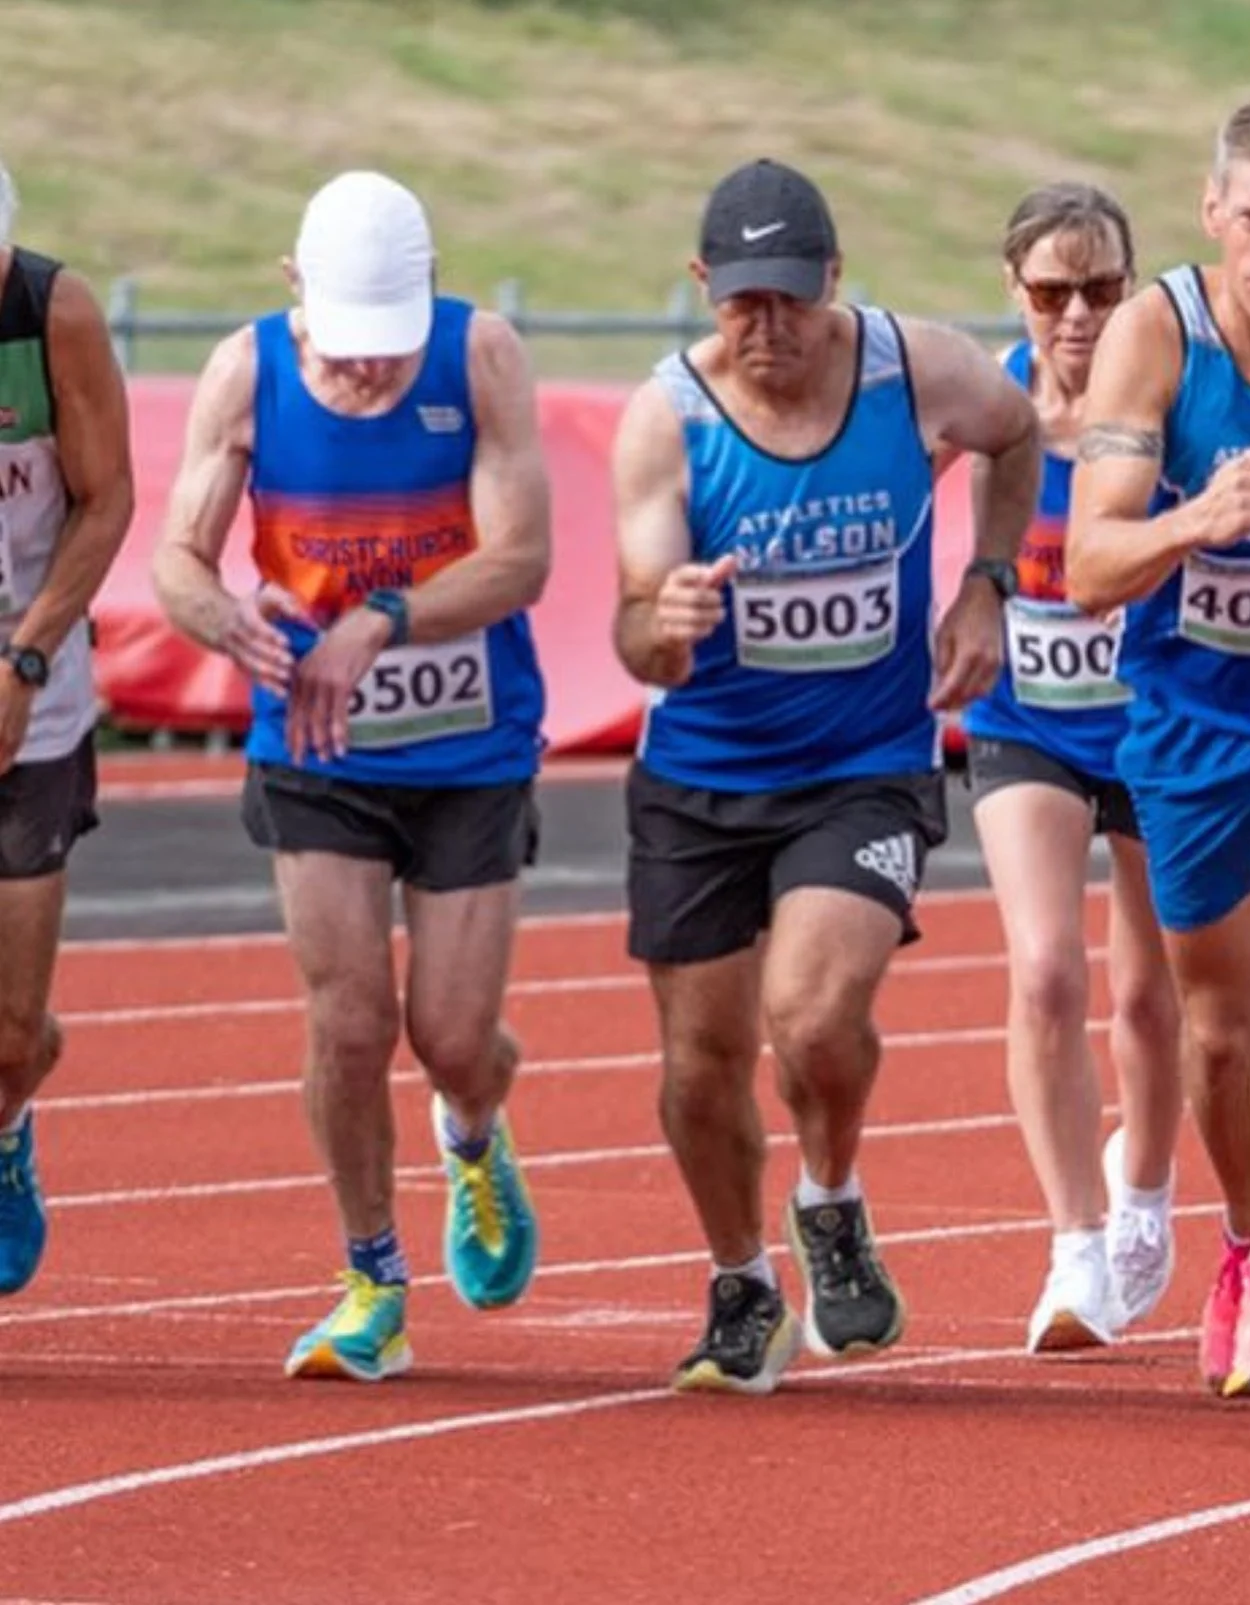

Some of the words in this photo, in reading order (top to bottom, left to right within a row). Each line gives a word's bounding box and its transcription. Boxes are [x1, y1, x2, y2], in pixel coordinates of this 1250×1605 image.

[737, 489, 891, 536] ATHLETICS
[289, 523, 470, 566] CHRISTCHURCH
[734, 517, 895, 571] NELSON
[345, 562, 414, 592] AVON
[744, 583, 892, 642] 5003
[1018, 633, 1116, 680] 500
